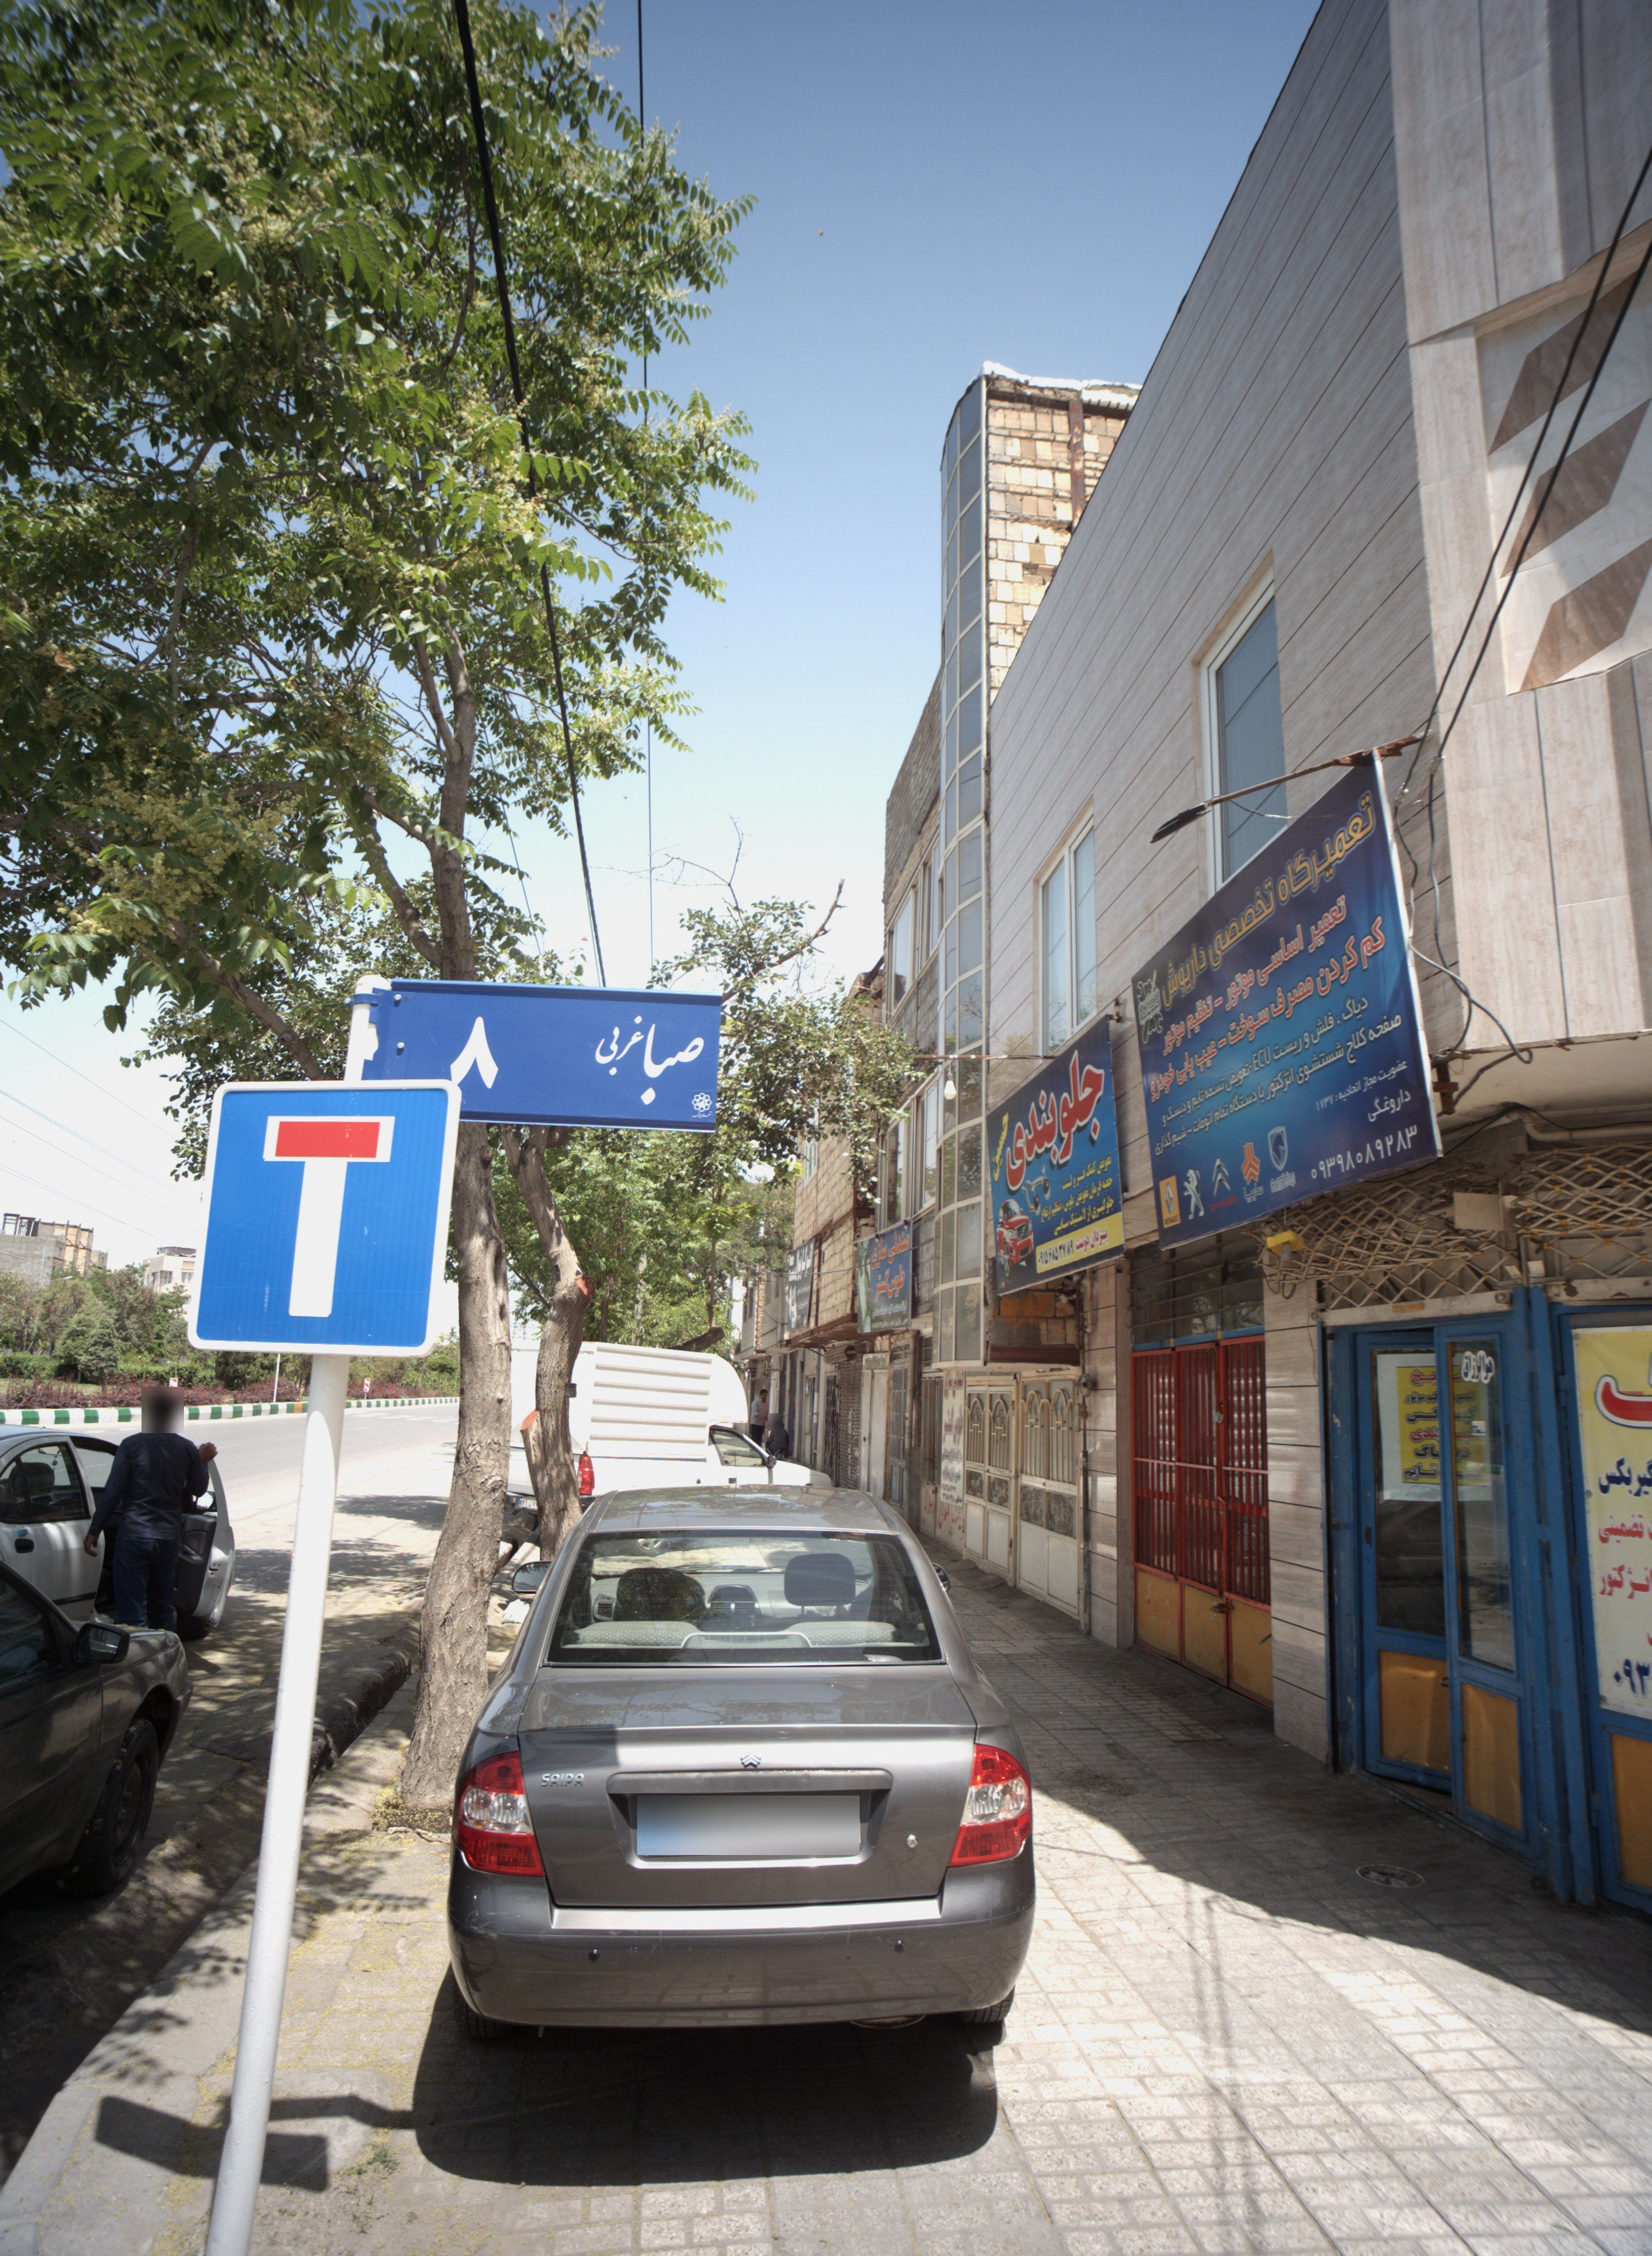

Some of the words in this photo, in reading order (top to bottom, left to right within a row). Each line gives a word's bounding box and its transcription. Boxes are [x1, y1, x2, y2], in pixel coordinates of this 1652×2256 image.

[1278, 792, 1375, 903] تعمیرگاه
[1209, 878, 1275, 970] تخصصی
[1309, 895, 1346, 952] تعمیر
[1257, 924, 1303, 986] اساسی
[1361, 916, 1385, 969] کم
[1162, 944, 1208, 1010] داریوش
[1317, 935, 1358, 996] کردن
[1226, 969, 1254, 1011] موتور
[1271, 977, 1314, 1018] مصرف
[1187, 995, 1213, 1038] تنظیم
[1228, 1007, 1269, 1045] سوخت
[1341, 997, 1368, 1021] دیاگ
[1163, 1021, 1185, 1056] موتور
[1304, 1032, 1309, 1048] و
[1311, 1011, 1334, 1044] فلش
[1368, 1014, 1401, 1040] صفحه
[450, 1016, 498, 1088] ۸
[595, 1015, 644, 1075] غربی
[1195, 1040, 1217, 1071] عیب
[1253, 1046, 1270, 1071] ECU
[1273, 1037, 1302, 1060] ریست
[640, 1024, 704, 1105] صبا
[1297, 1042, 1344, 1084] شستشوی
[1378, 1060, 1408, 1081] عضویت
[1150, 1062, 1175, 1102] خودرو
[1205, 1078, 1225, 1099] تسمه
[1258, 1084, 1264, 1103] با
[1363, 1075, 1377, 1092] مجاز
[1167, 1100, 1186, 1121] دیسک
[1192, 1089, 1204, 1111] تایم
[1214, 1104, 1229, 1127] تمام
[1229, 1091, 1258, 1113] دستگاه
[1368, 1089, 1411, 1122] داروغگی
[1311, 1125, 1417, 1179] ۰۹۳۹۸۰۸۹۲۸۳
[1599, 1514, 1643, 1543] تضمینی
[542, 1773, 584, 1787] SAIPA
